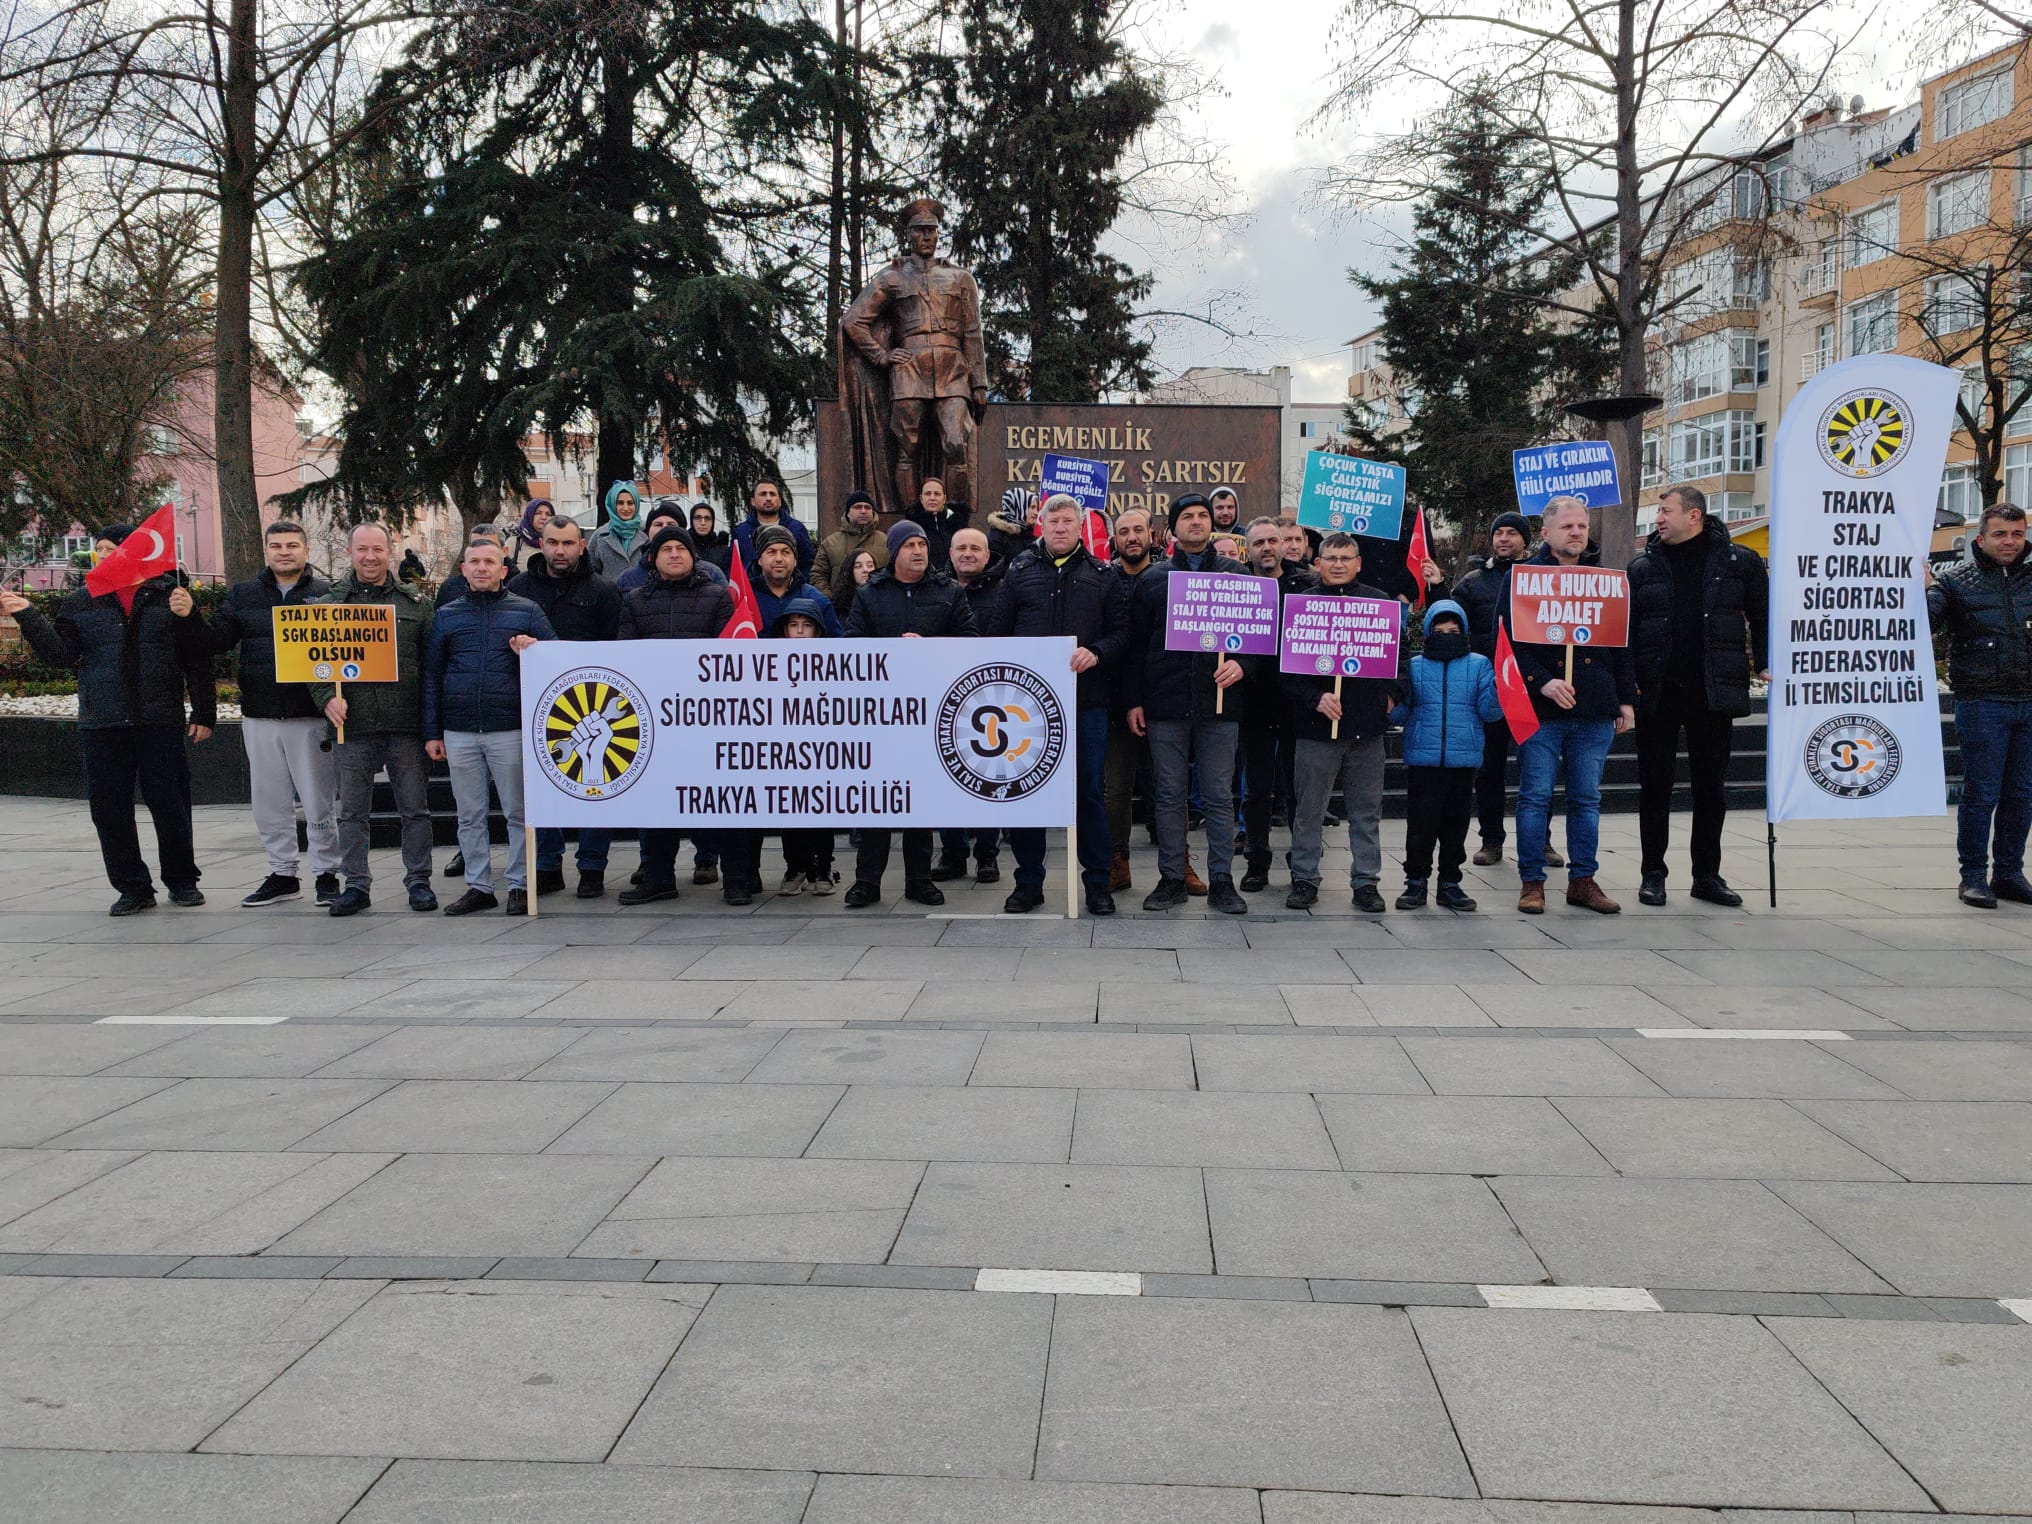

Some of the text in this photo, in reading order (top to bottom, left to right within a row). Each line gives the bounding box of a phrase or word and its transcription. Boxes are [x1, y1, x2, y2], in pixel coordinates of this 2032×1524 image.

[1006, 420, 1153, 451] EGEMENLİK
[1519, 446, 1609, 473] STAJ VE ÇIRAKLIK
[1141, 460, 1246, 485] ŞARTSIZ
[1331, 472, 1381, 491] ÇALIŞTIK
[1545, 469, 1614, 497] ÇALIŞMADIR
[1314, 481, 1392, 506] SİGORTAMIZI
[1822, 490, 1896, 514] TRAKYA
[1329, 497, 1374, 517] İSTERİZ
[1833, 523, 1881, 546] STAJ
[1797, 555, 1913, 581] VE ÇIRAKLIK
[1185, 590, 1262, 605] SON VERİLSİN!
[1187, 577, 1261, 593] HAK GASBINA
[1516, 572, 1624, 598] HAK HUKUK
[1803, 582, 1905, 610] SİGORTASI
[280, 608, 388, 625] STAJ VE ÇIRAKLIK
[1173, 603, 1273, 621] STAJ VE ÇIRAKLIK SGK
[1305, 600, 1380, 615] SOSYAL DEVLET
[1536, 600, 1603, 625] ADALET
[1173, 620, 1272, 635] BAŞLANGICI OLSUN
[1294, 614, 1390, 630] SOSYAL SORUNLARI
[1790, 614, 1916, 642] MAĞDURLARI
[282, 627, 388, 646] SGK BAŞLANGICI
[1285, 625, 1396, 645] ÇÖZMEK İÇİN VARDIR.
[308, 647, 365, 661] OLSUN
[1291, 642, 1388, 659] BAKANIN SÖYLEMİ.
[1791, 649, 1916, 674] FEDERASYON
[698, 653, 889, 687] STAJ VE ÇIRAKLIK
[552, 672, 601, 696] MAĞDURLARI
[602, 673, 645, 716] FEDERASYONU
[950, 668, 1001, 703] SİGORTASI
[1801, 675, 1924, 705] TEMSİLCİLİĞİ
[536, 695, 553, 734] SİGORTASI
[660, 692, 927, 727] SİGORTASI MAĞDURLARI
[940, 703, 957, 756] ÇIRAKLIK
[715, 741, 871, 770] FEDERASYONU
[947, 755, 962, 773] VE
[1019, 722, 1061, 792] FEDERASYONU
[552, 769, 562, 783] VE
[562, 777, 579, 792] STAJ
[958, 770, 982, 792] STAJ
[675, 780, 911, 814] TRAKYA TEMSİLCİLİĞİ
